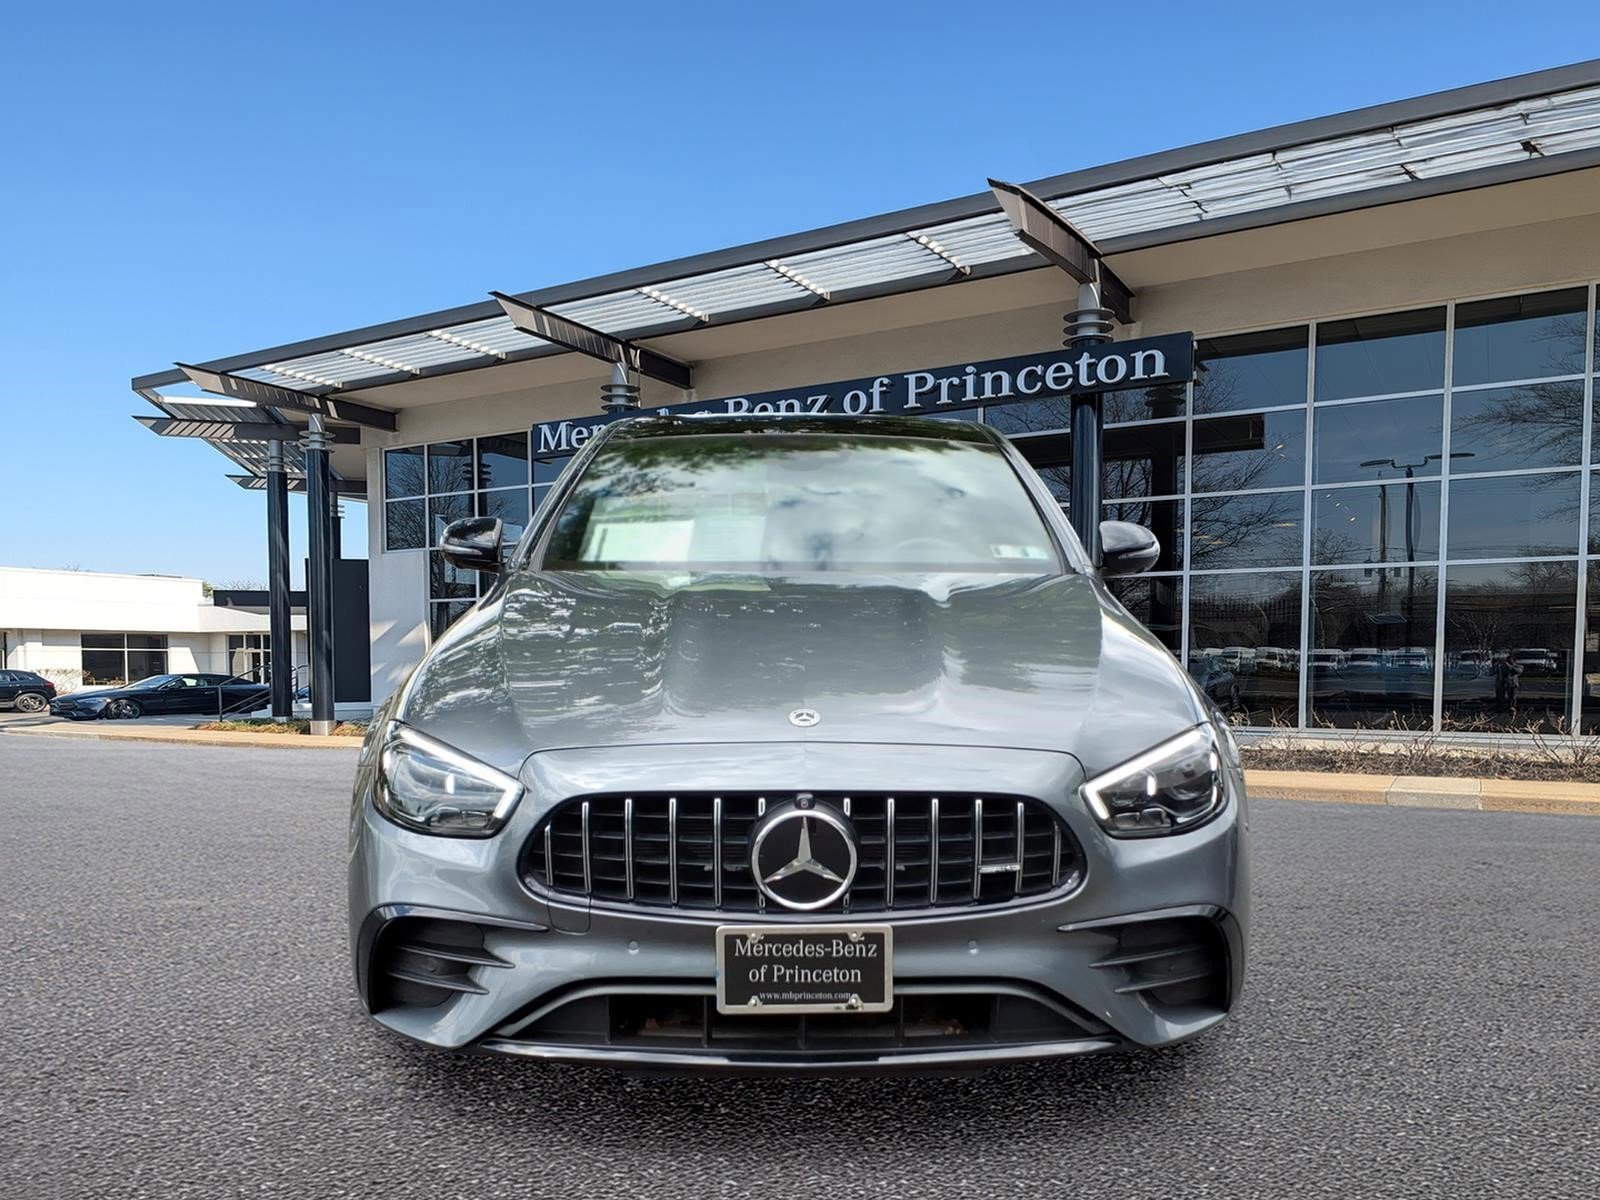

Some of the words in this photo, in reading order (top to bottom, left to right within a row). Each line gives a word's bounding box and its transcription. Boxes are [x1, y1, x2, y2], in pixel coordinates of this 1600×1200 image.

[537, 394, 829, 453] MerBenz
[842, 377, 889, 415] of
[903, 348, 1169, 409] Princeton
[734, 938, 878, 958] Mercedes-Benz
[748, 964, 768, 983] of
[772, 964, 862, 983] Princeton
[759, 990, 851, 1002] www.mbprinceton.com
